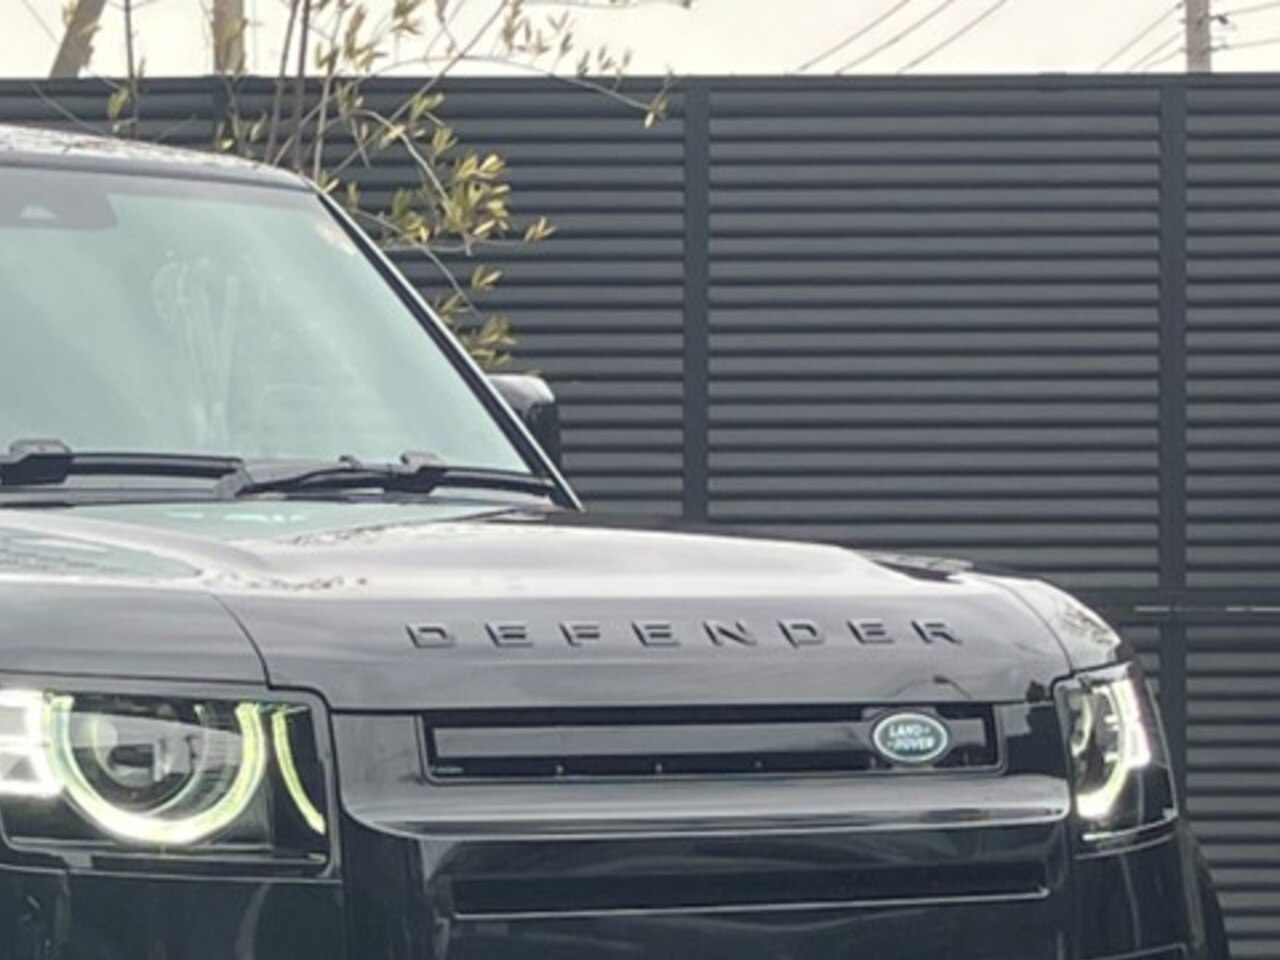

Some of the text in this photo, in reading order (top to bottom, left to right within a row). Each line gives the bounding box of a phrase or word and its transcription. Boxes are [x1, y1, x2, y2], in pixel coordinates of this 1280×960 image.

[405, 620, 963, 650] DEFENDER
[889, 724, 923, 738] LAND
[894, 737, 934, 751] ROVER
